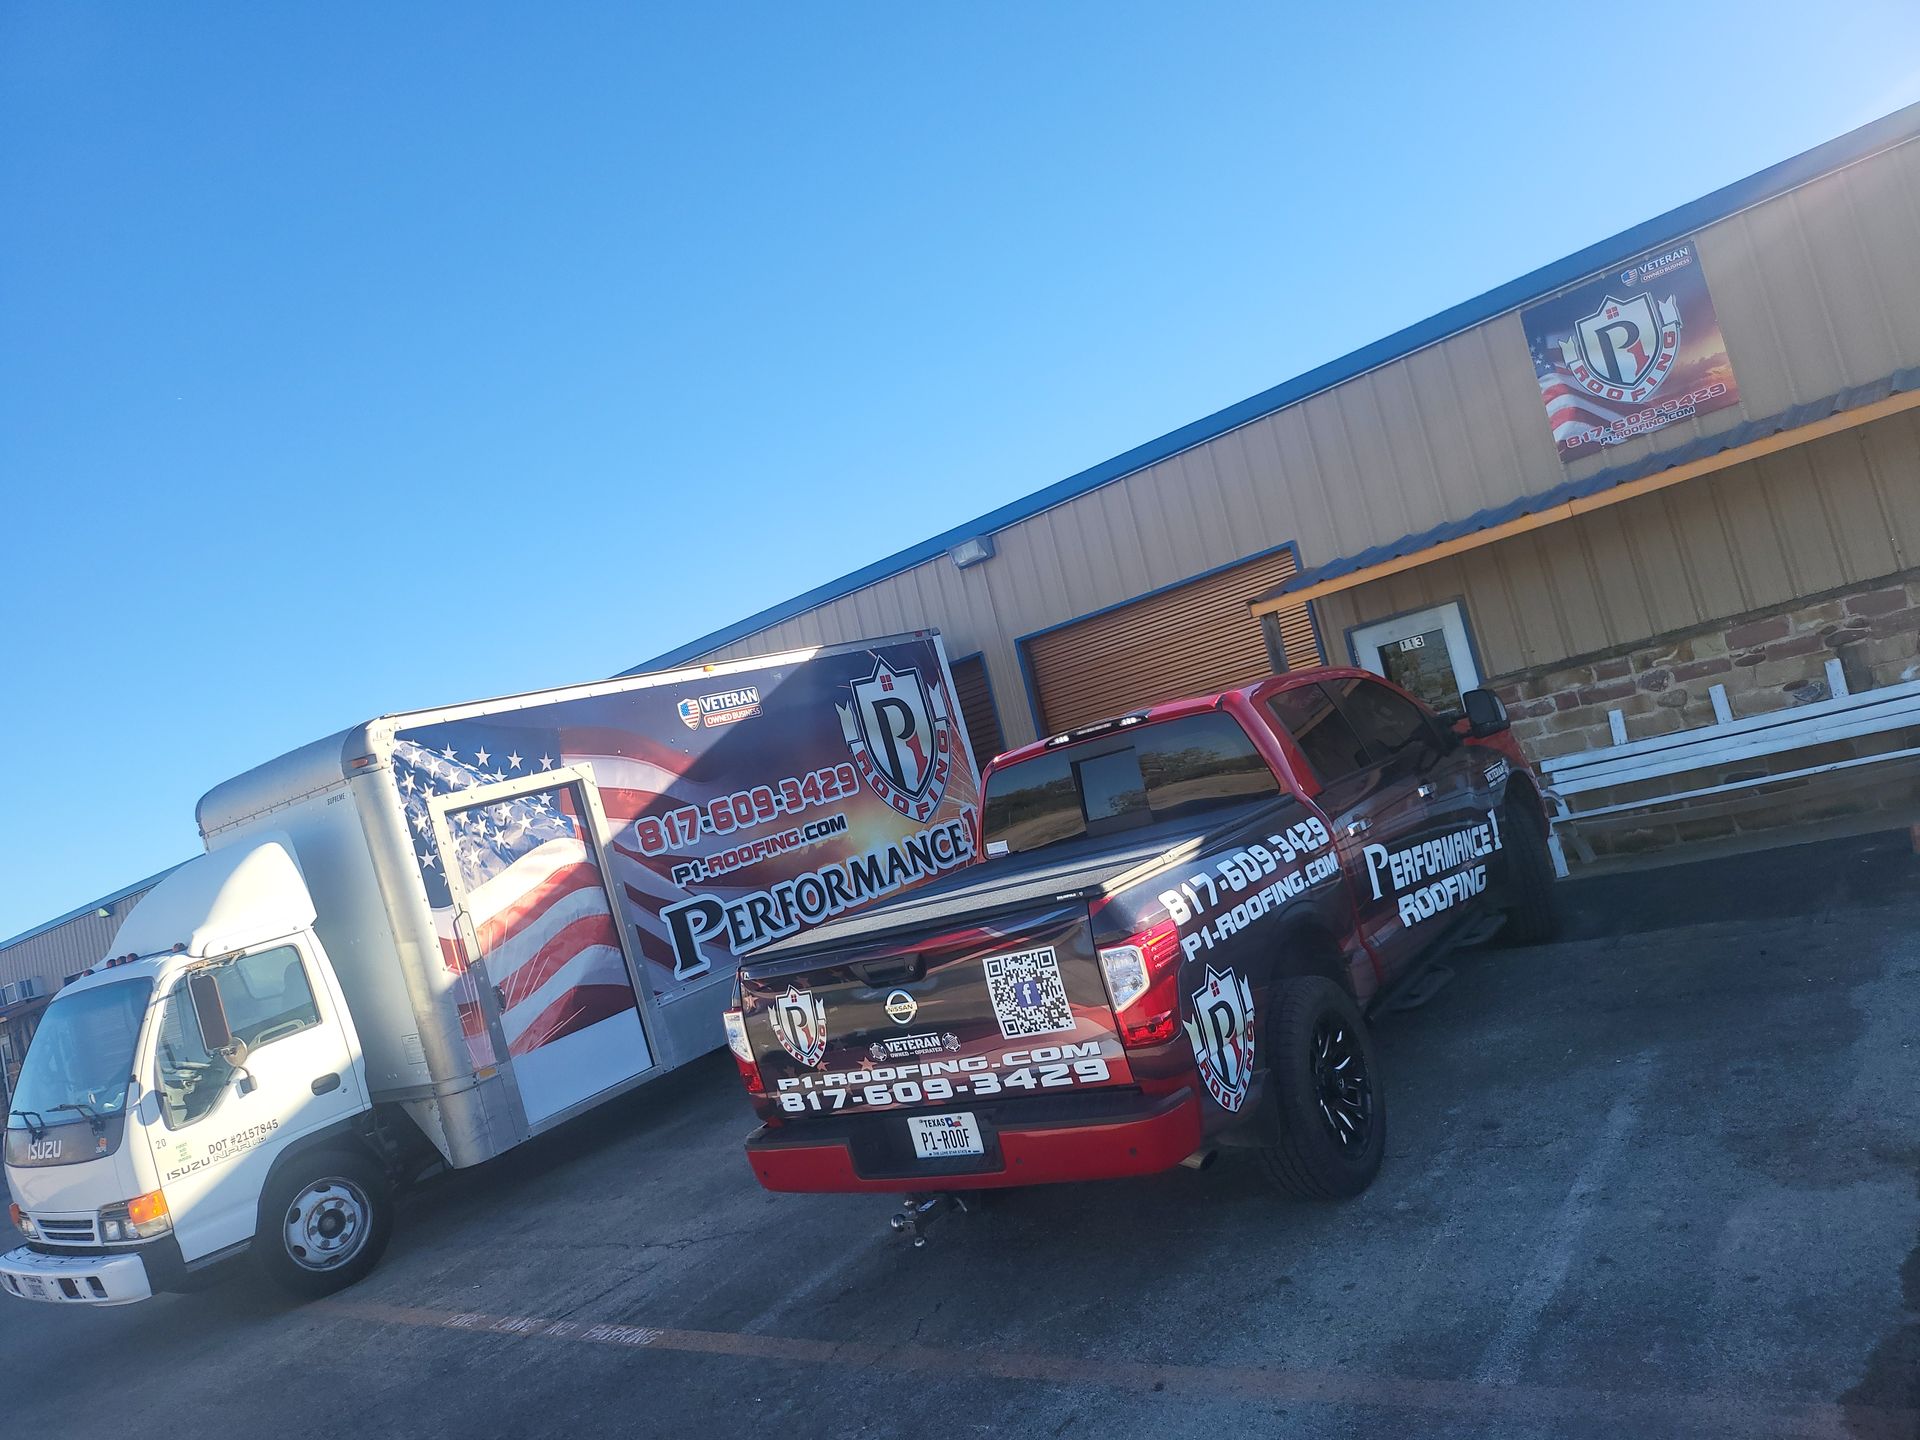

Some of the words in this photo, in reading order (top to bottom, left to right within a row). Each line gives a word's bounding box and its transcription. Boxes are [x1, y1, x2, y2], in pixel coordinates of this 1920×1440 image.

[1639, 247, 1689, 273] VETERAN
[1574, 331, 1676, 402] ROOFING
[1566, 383, 1727, 448] 817-609-3429
[1600, 406, 1696, 445] P1-ROOFING.COM
[1401, 637, 1423, 650] 113
[701, 688, 758, 712] VETERAN
[707, 713, 733, 725] OWNED
[732, 707, 761, 720] BUSINESS
[855, 729, 949, 821] ROOFING
[636, 763, 858, 855] 817-609-3429
[674, 814, 848, 885] P1-ROOFING.COM
[1362, 822, 1492, 901] PERFORMANCE
[1158, 816, 1331, 927] 817-609-3429
[662, 822, 968, 976] PERFORMANCE
[1180, 850, 1340, 962] P1-ROOFING.COM
[1397, 865, 1487, 928] ROOFING
[887, 1003, 914, 1014] NISSAN
[776, 1024, 827, 1066] ROOFING
[885, 1035, 941, 1053] VETERAN
[1200, 1020, 1254, 1110] ROOFING
[777, 1041, 1103, 1091] P1-ROOFING.COM
[778, 1058, 1111, 1112] 817-609-3429
[155, 1138, 167, 1150] 20
[208, 1138, 228, 1155] DOT
[230, 1119, 279, 1146] #2157845
[921, 1128, 970, 1151] P1-ROOF
[923, 1118, 946, 1128] TEXAS
[28, 1140, 62, 1160] ISUZU
[166, 1157, 211, 1181] ISUZU
[213, 1142, 252, 1162] NPR
